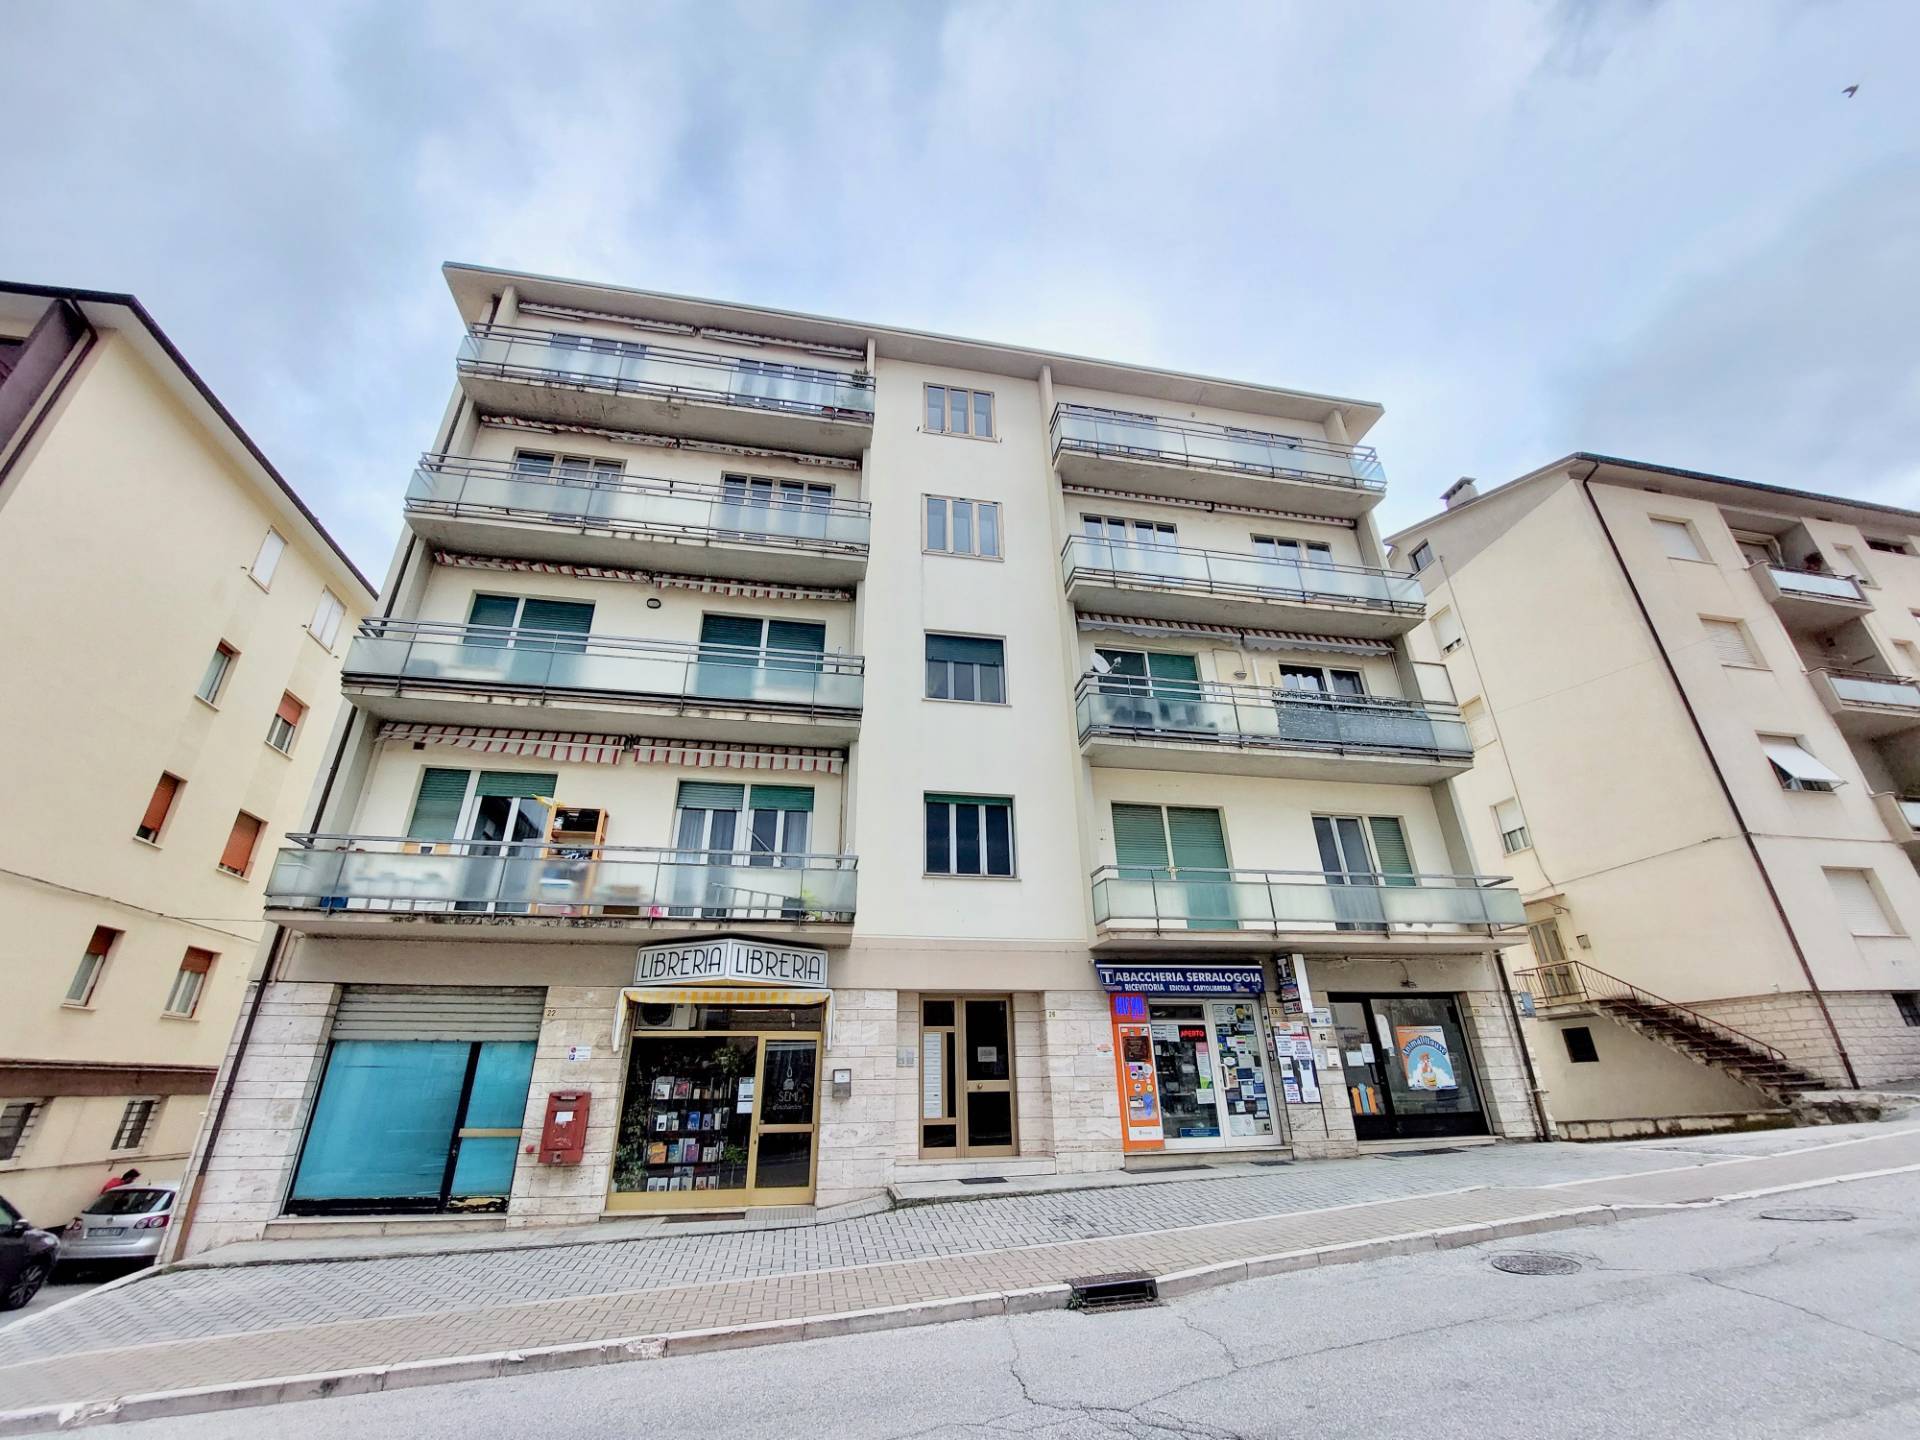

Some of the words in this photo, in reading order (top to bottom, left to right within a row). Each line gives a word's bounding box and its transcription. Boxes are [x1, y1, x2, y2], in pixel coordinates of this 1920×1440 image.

[640, 946, 722, 979] LIBRERIA
[735, 946, 821, 981] LIBRERIA
[1186, 971, 1262, 983] SERRALOGGIA
[1124, 983, 1165, 992] RICEVITORIA
[1169, 984, 1191, 992] EDICOLA
[1193, 984, 1232, 992] CARTOLIBRERIA
[546, 1009, 557, 1017] 22
[1180, 1029, 1205, 1038] APERTO
